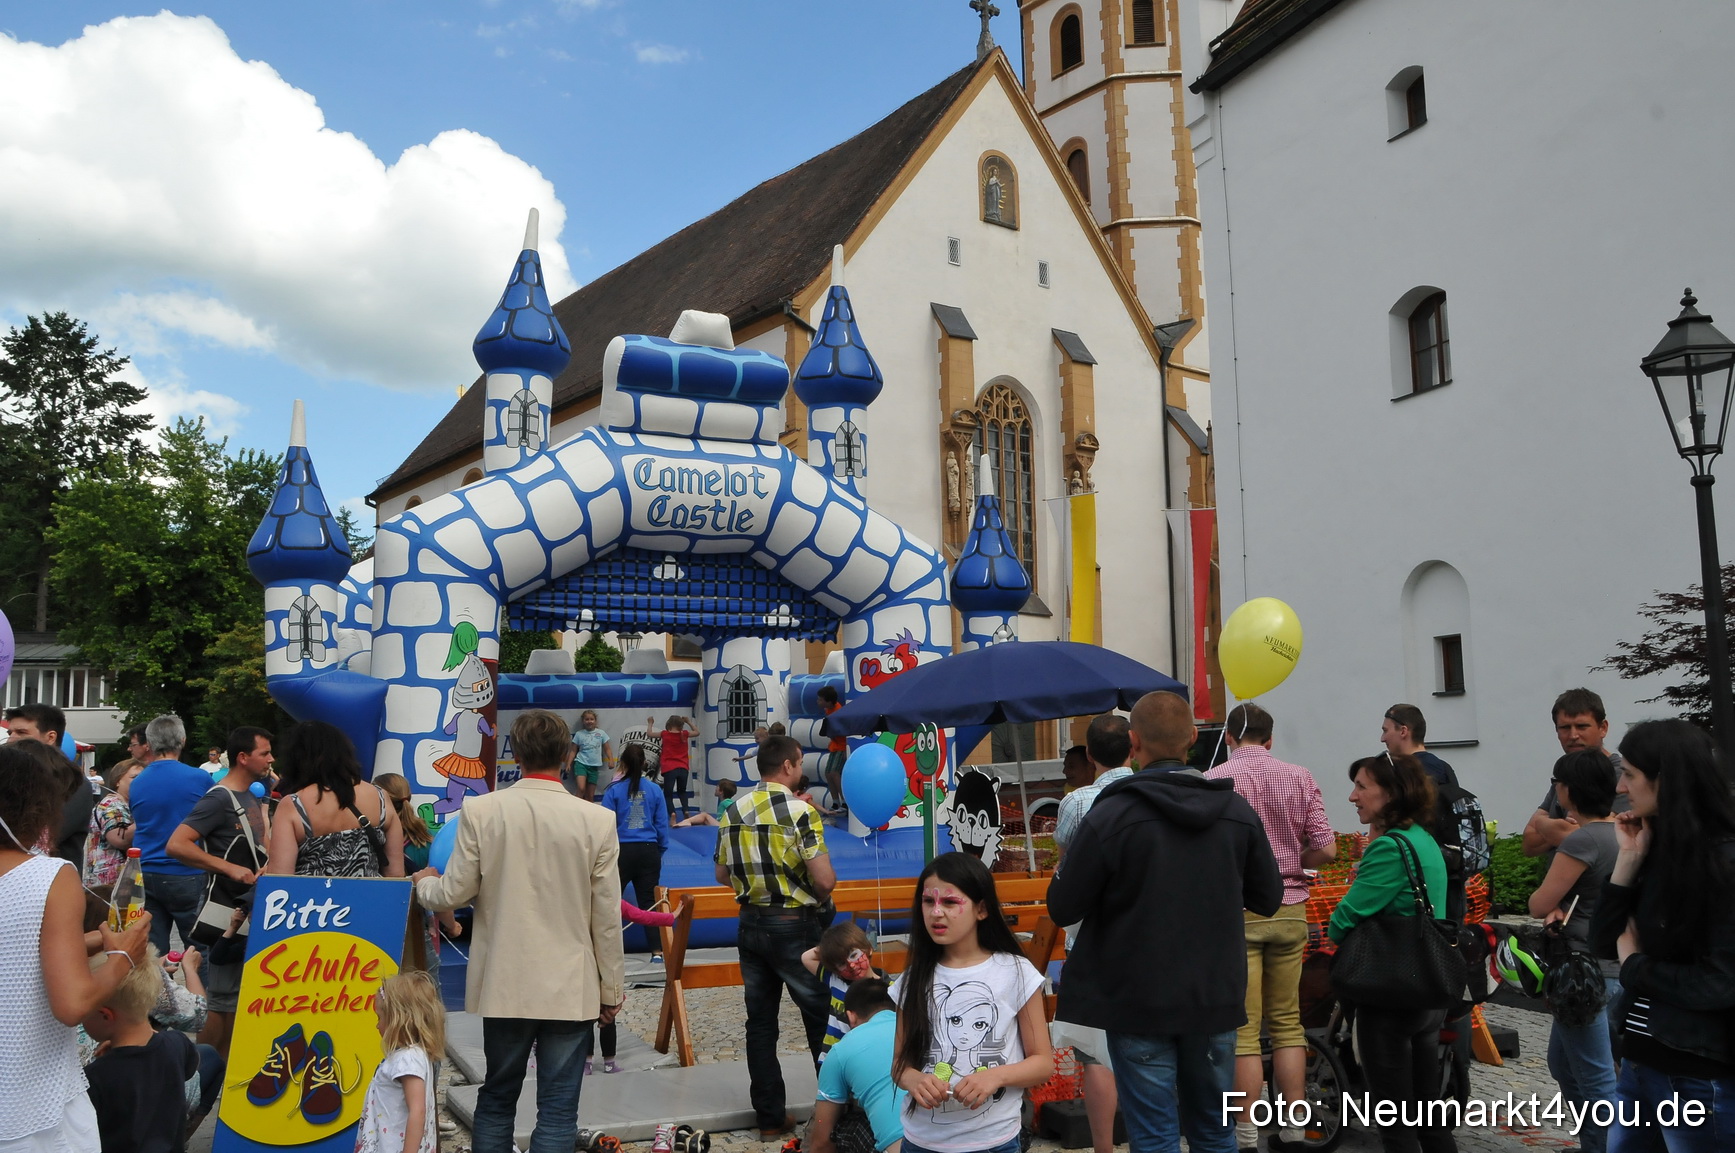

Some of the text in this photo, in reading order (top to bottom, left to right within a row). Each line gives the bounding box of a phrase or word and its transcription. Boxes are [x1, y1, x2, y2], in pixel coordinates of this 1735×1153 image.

[633, 457, 769, 499] Camelot
[647, 495, 754, 532] Castle
[263, 889, 351, 931] Bitte
[260, 943, 380, 988] Schuhe
